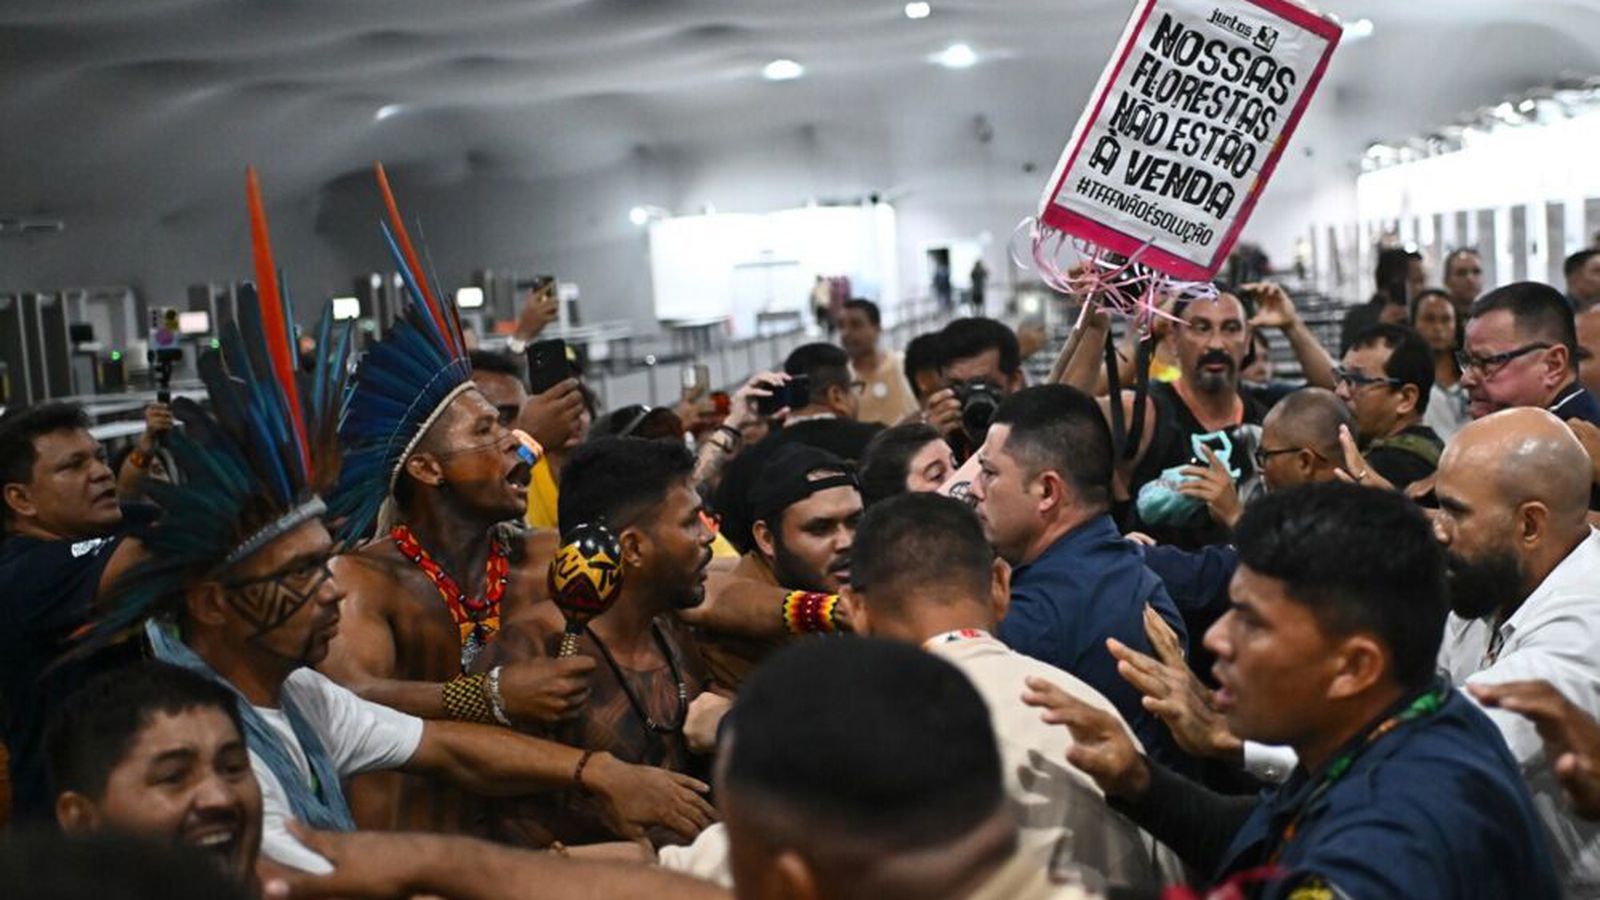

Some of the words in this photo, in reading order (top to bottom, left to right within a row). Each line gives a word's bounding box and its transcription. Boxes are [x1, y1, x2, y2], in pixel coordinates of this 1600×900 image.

[1149, 12, 1296, 106] NOSSAS
[1206, 8, 1253, 37] juntos
[1108, 91, 1168, 146] NÃO
[1166, 117, 1257, 179] ESTÃO
[1129, 51, 1277, 142] FLORESTAS
[1075, 176, 1214, 247] #TFFFNÃOÉSOLUÇÃO
[1088, 127, 1122, 176] À
[1123, 149, 1235, 220] VENDA
